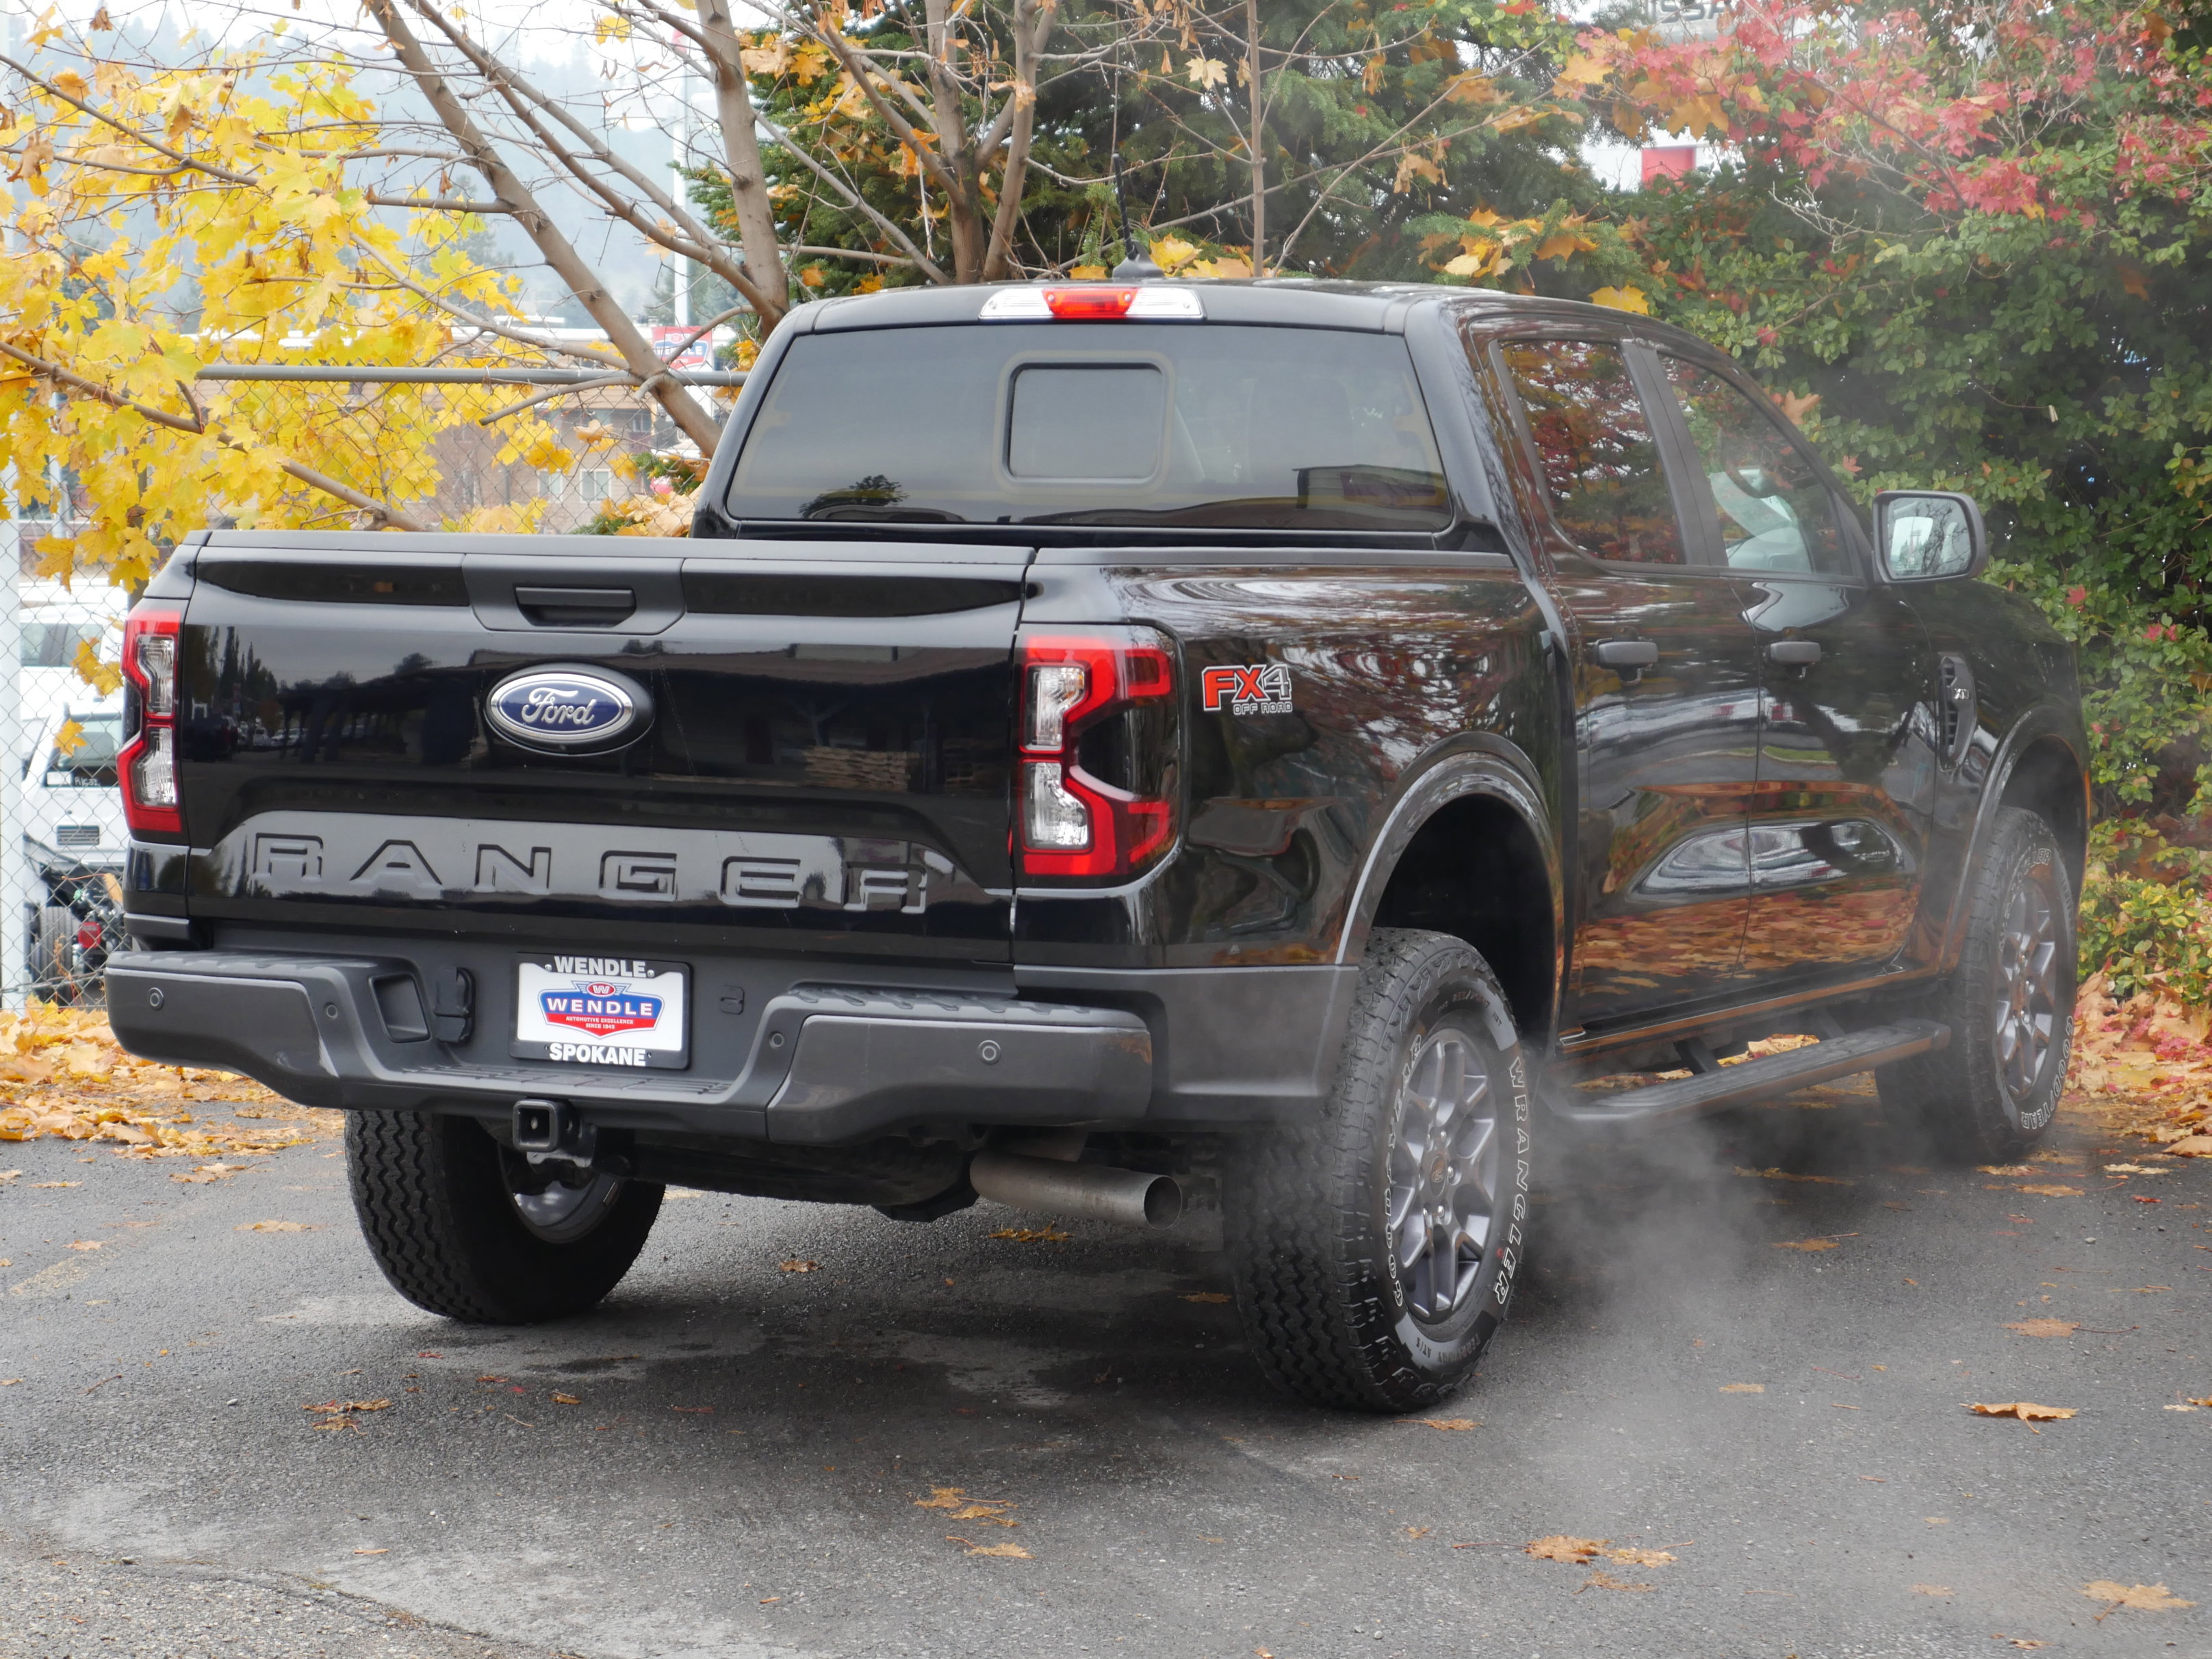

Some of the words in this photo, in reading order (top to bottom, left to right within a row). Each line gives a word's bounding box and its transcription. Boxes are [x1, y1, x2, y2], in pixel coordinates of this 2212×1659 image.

[1202, 664, 1292, 711] FX4
[522, 686, 597, 725] Ford
[1233, 704, 1257, 715] OFF
[1261, 702, 1292, 713] ROAD
[253, 832, 927, 914] RANGER
[554, 955, 647, 978] WENDLE
[548, 998, 652, 1016] WENDLE
[550, 1043, 646, 1066] SPOKANE
[1493, 1056, 1530, 1304] WRANGLER
